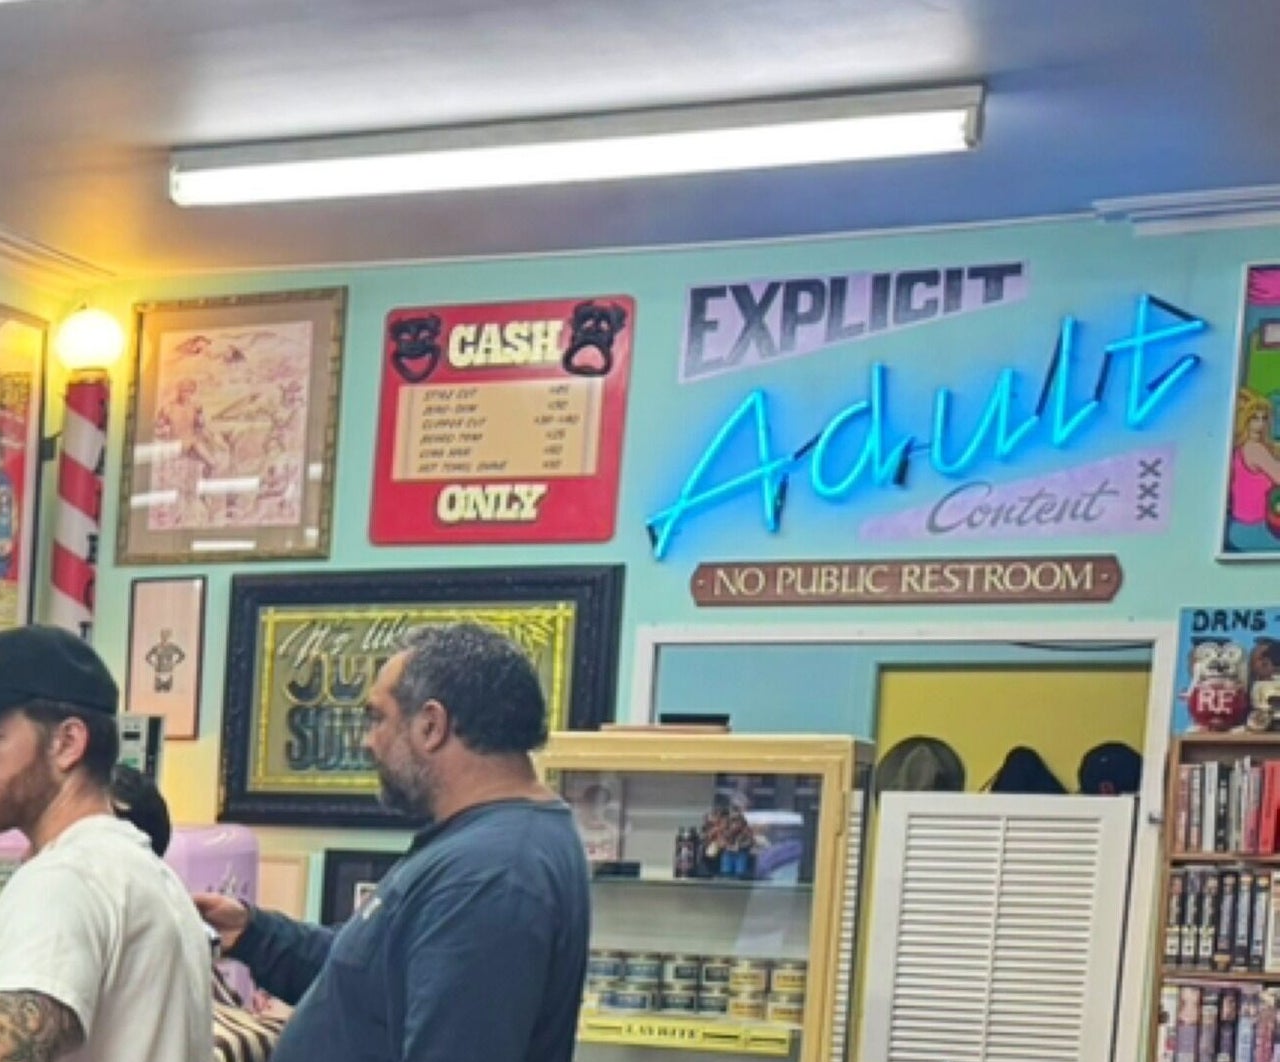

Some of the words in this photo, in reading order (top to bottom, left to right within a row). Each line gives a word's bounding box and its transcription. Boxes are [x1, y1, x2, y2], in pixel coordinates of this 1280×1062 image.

[449, 320, 563, 369] CASH
[686, 262, 1022, 379] EXPLICIT
[646, 294, 1209, 561] Adult
[437, 484, 548, 523] ONLY
[926, 480, 1122, 536] Content
[714, 566, 766, 597] NO
[775, 563, 889, 596] PUBLIC
[900, 560, 1094, 593] RESTROOM
